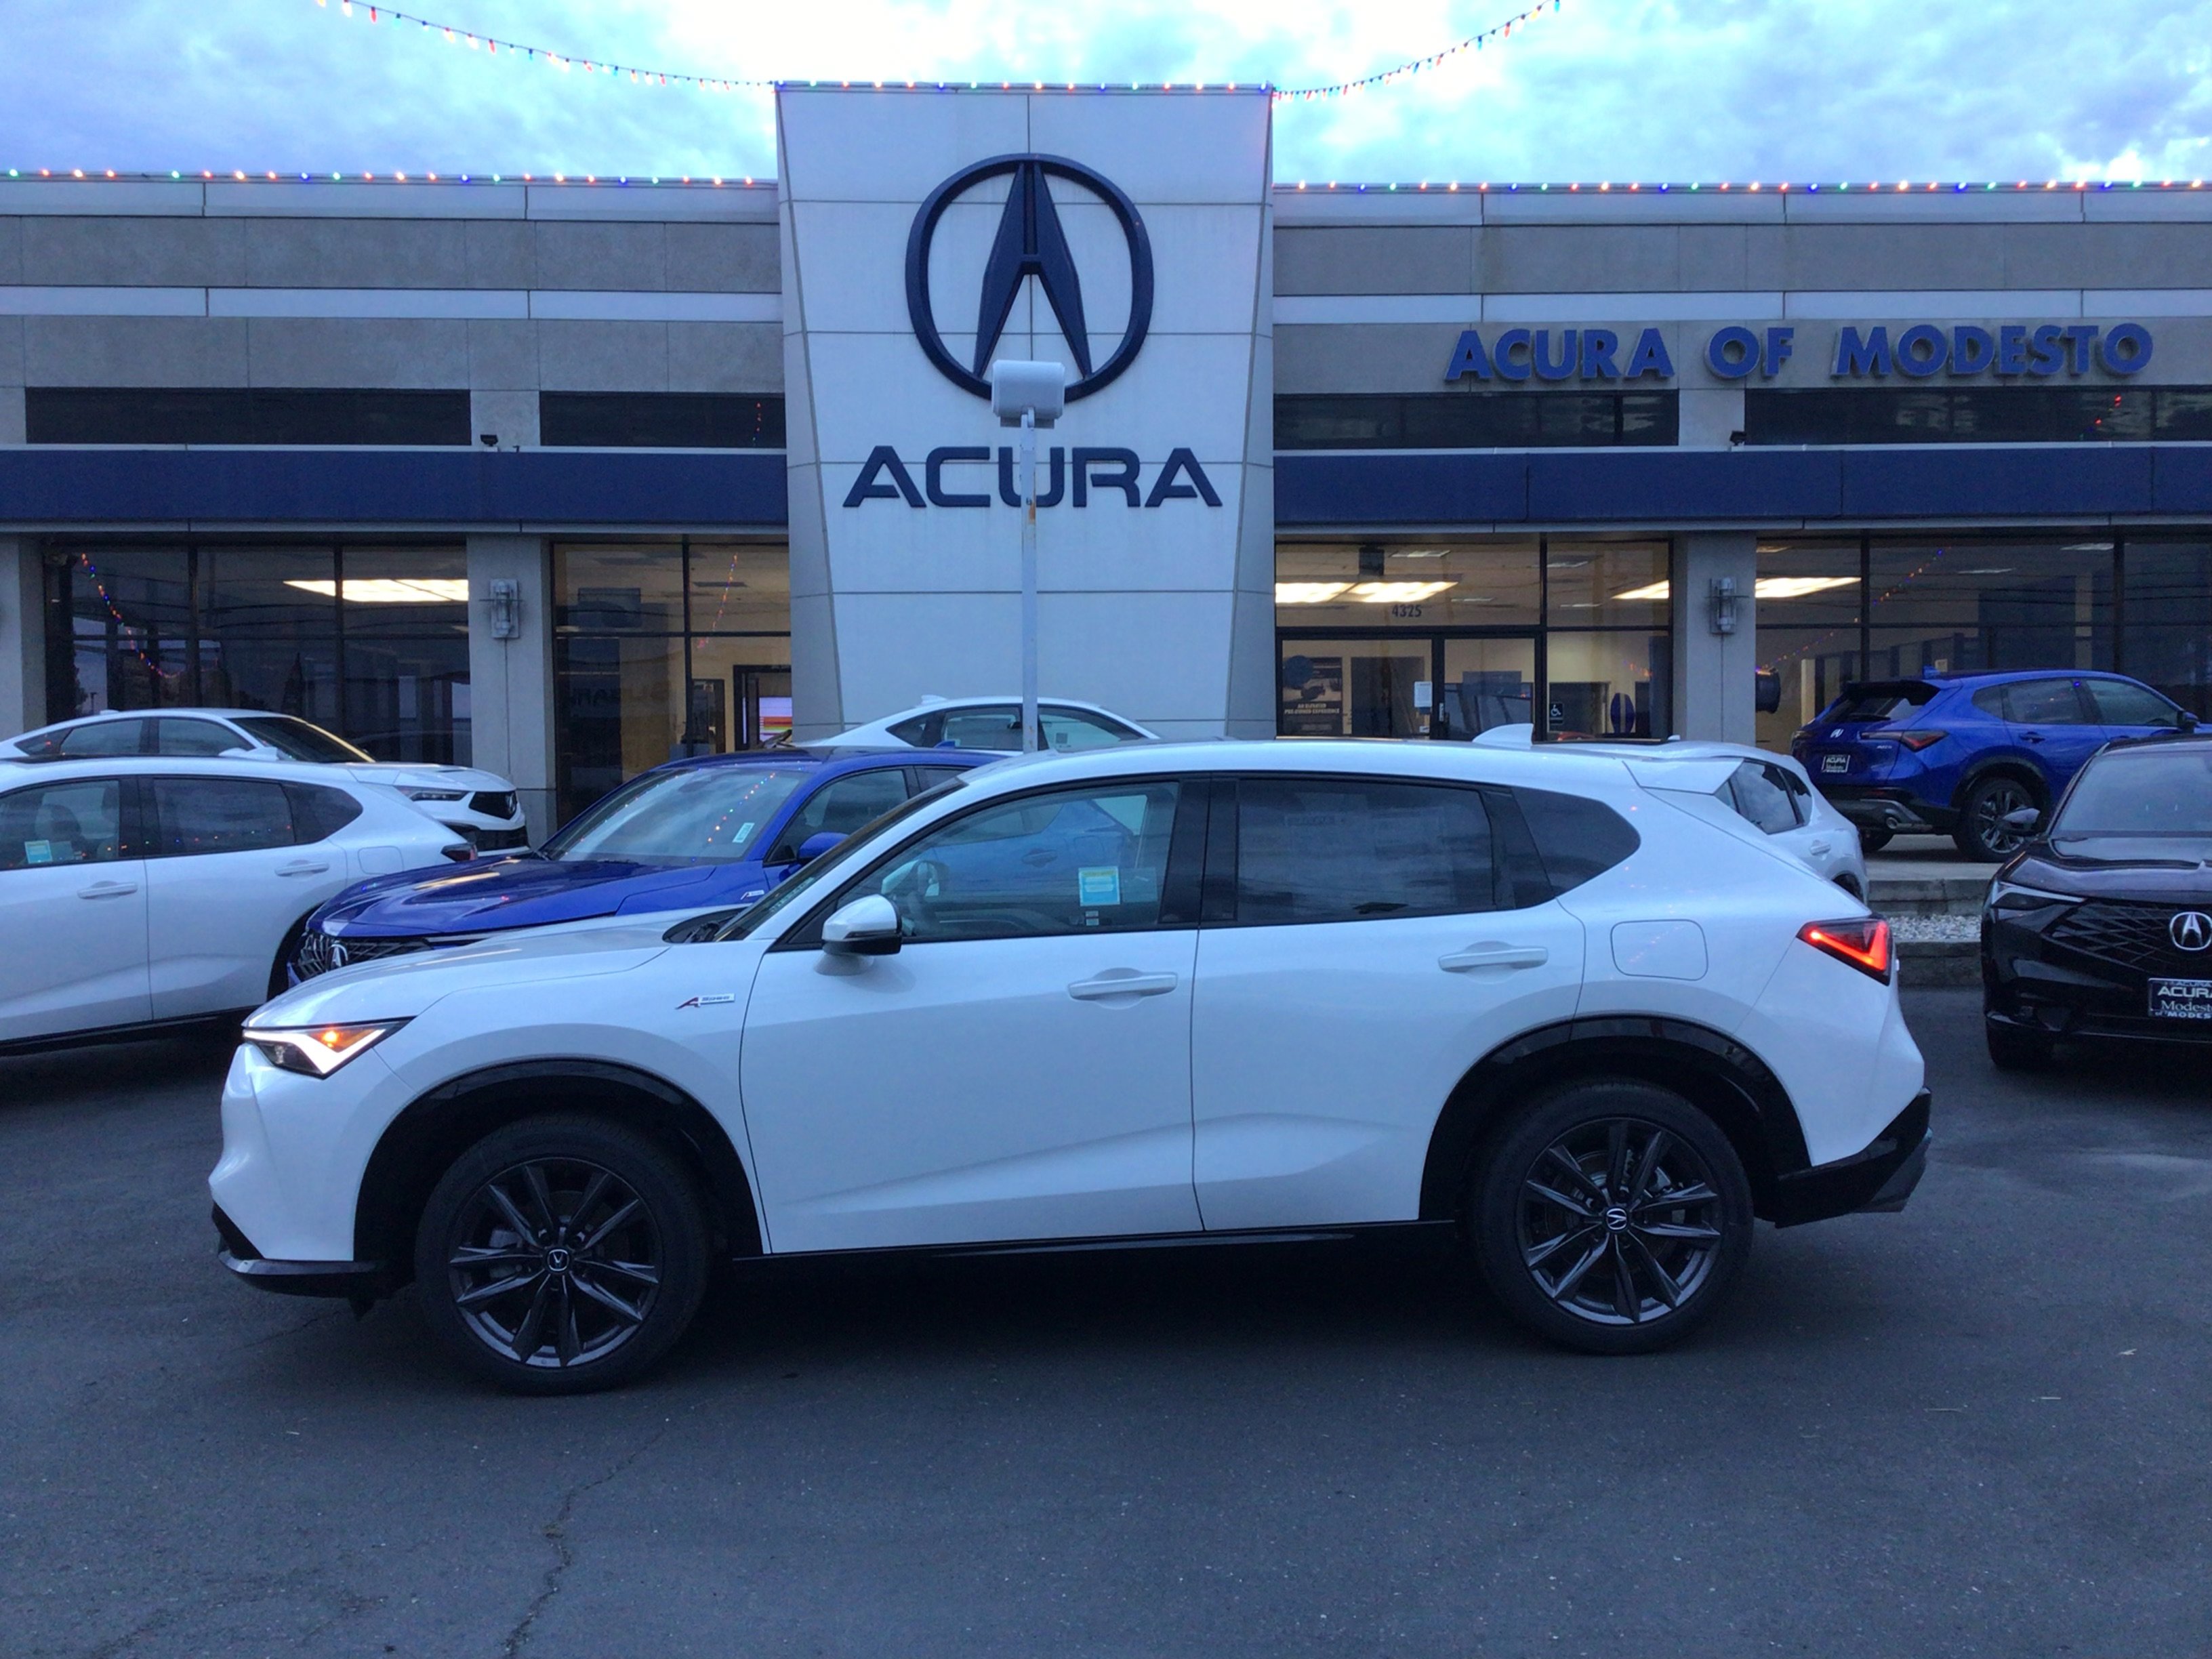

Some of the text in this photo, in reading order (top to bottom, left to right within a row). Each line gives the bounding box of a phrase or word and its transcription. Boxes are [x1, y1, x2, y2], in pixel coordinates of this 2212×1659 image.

[1444, 323, 2154, 381] ACURA OF MODESTO
[842, 445, 1223, 508] ACURA
[1391, 604, 1422, 617] 4325
